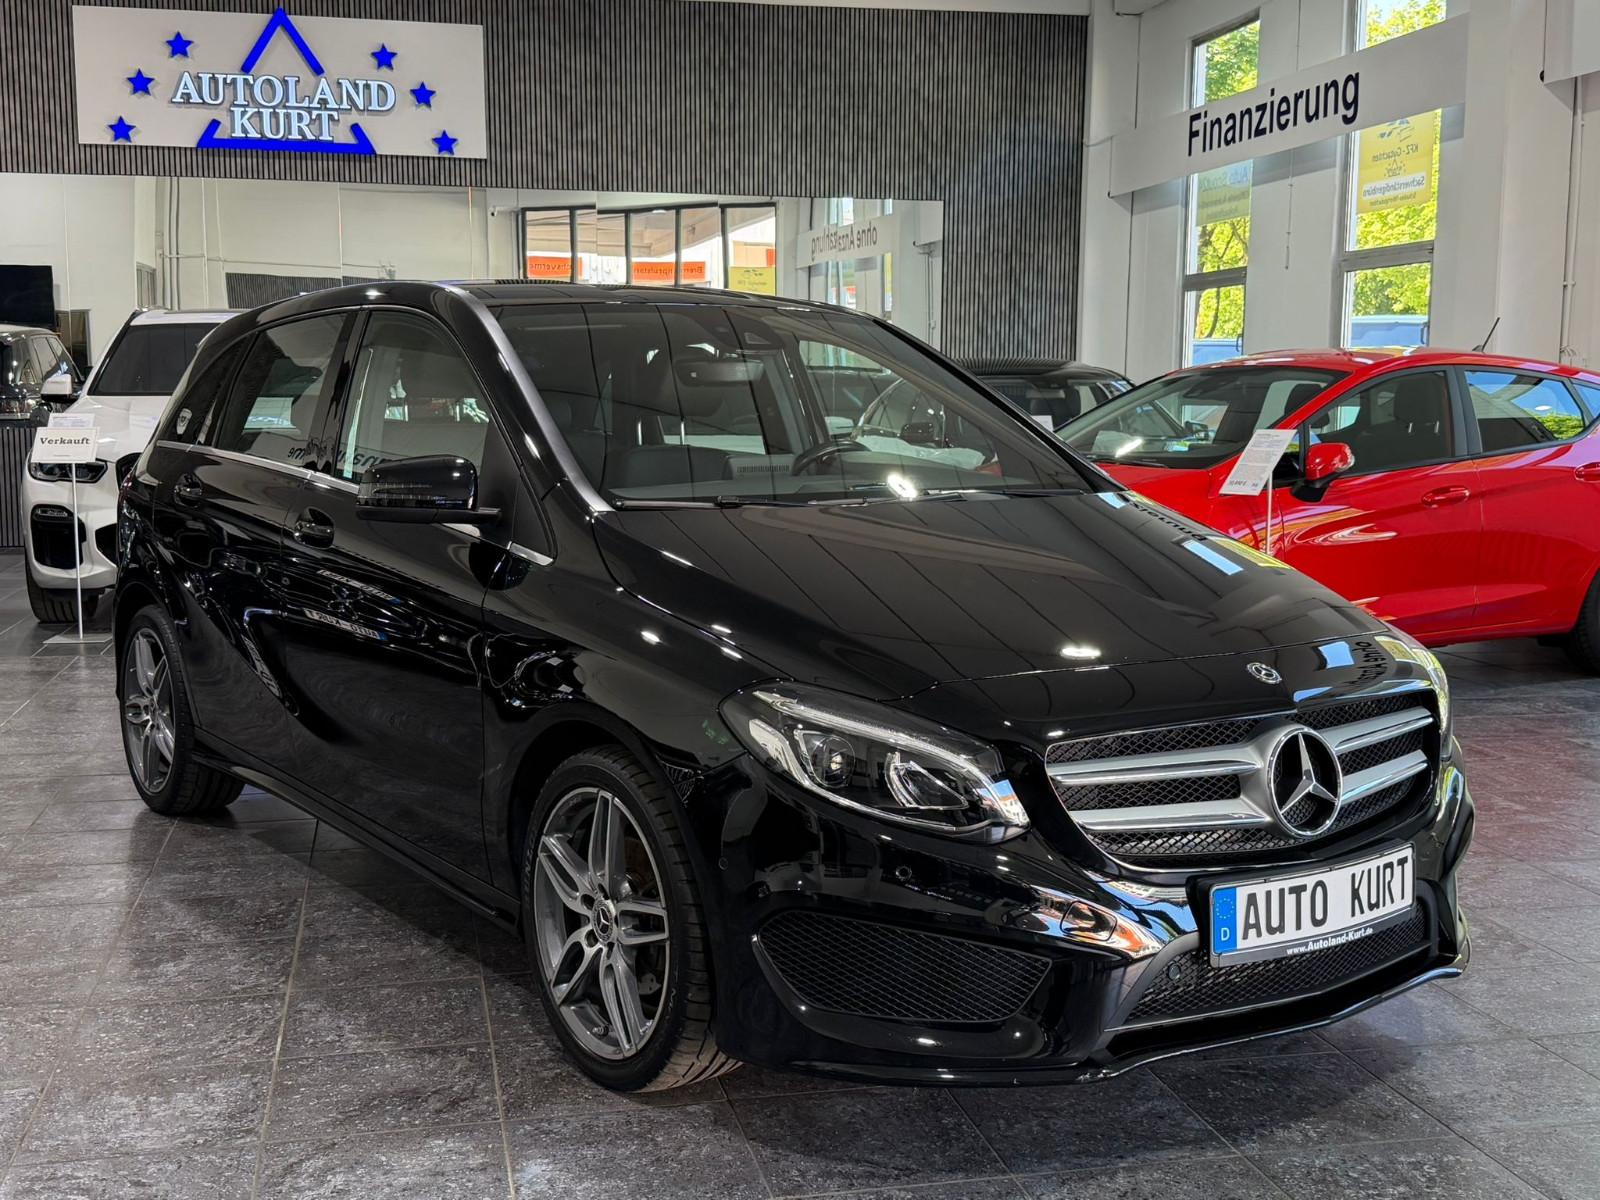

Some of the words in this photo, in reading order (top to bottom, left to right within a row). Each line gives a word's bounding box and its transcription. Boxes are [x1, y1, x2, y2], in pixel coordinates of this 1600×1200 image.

[172, 71, 396, 111] AUTOLAND
[230, 107, 339, 140] KURT
[1188, 72, 1360, 156] Finanzierung
[40, 437, 90, 445] Verkauft
[1242, 879, 1328, 940] AUTO
[1350, 856, 1409, 917] KURT
[1221, 927, 1230, 941] D
[1286, 926, 1373, 955] www.Autoland-Kurt.de
